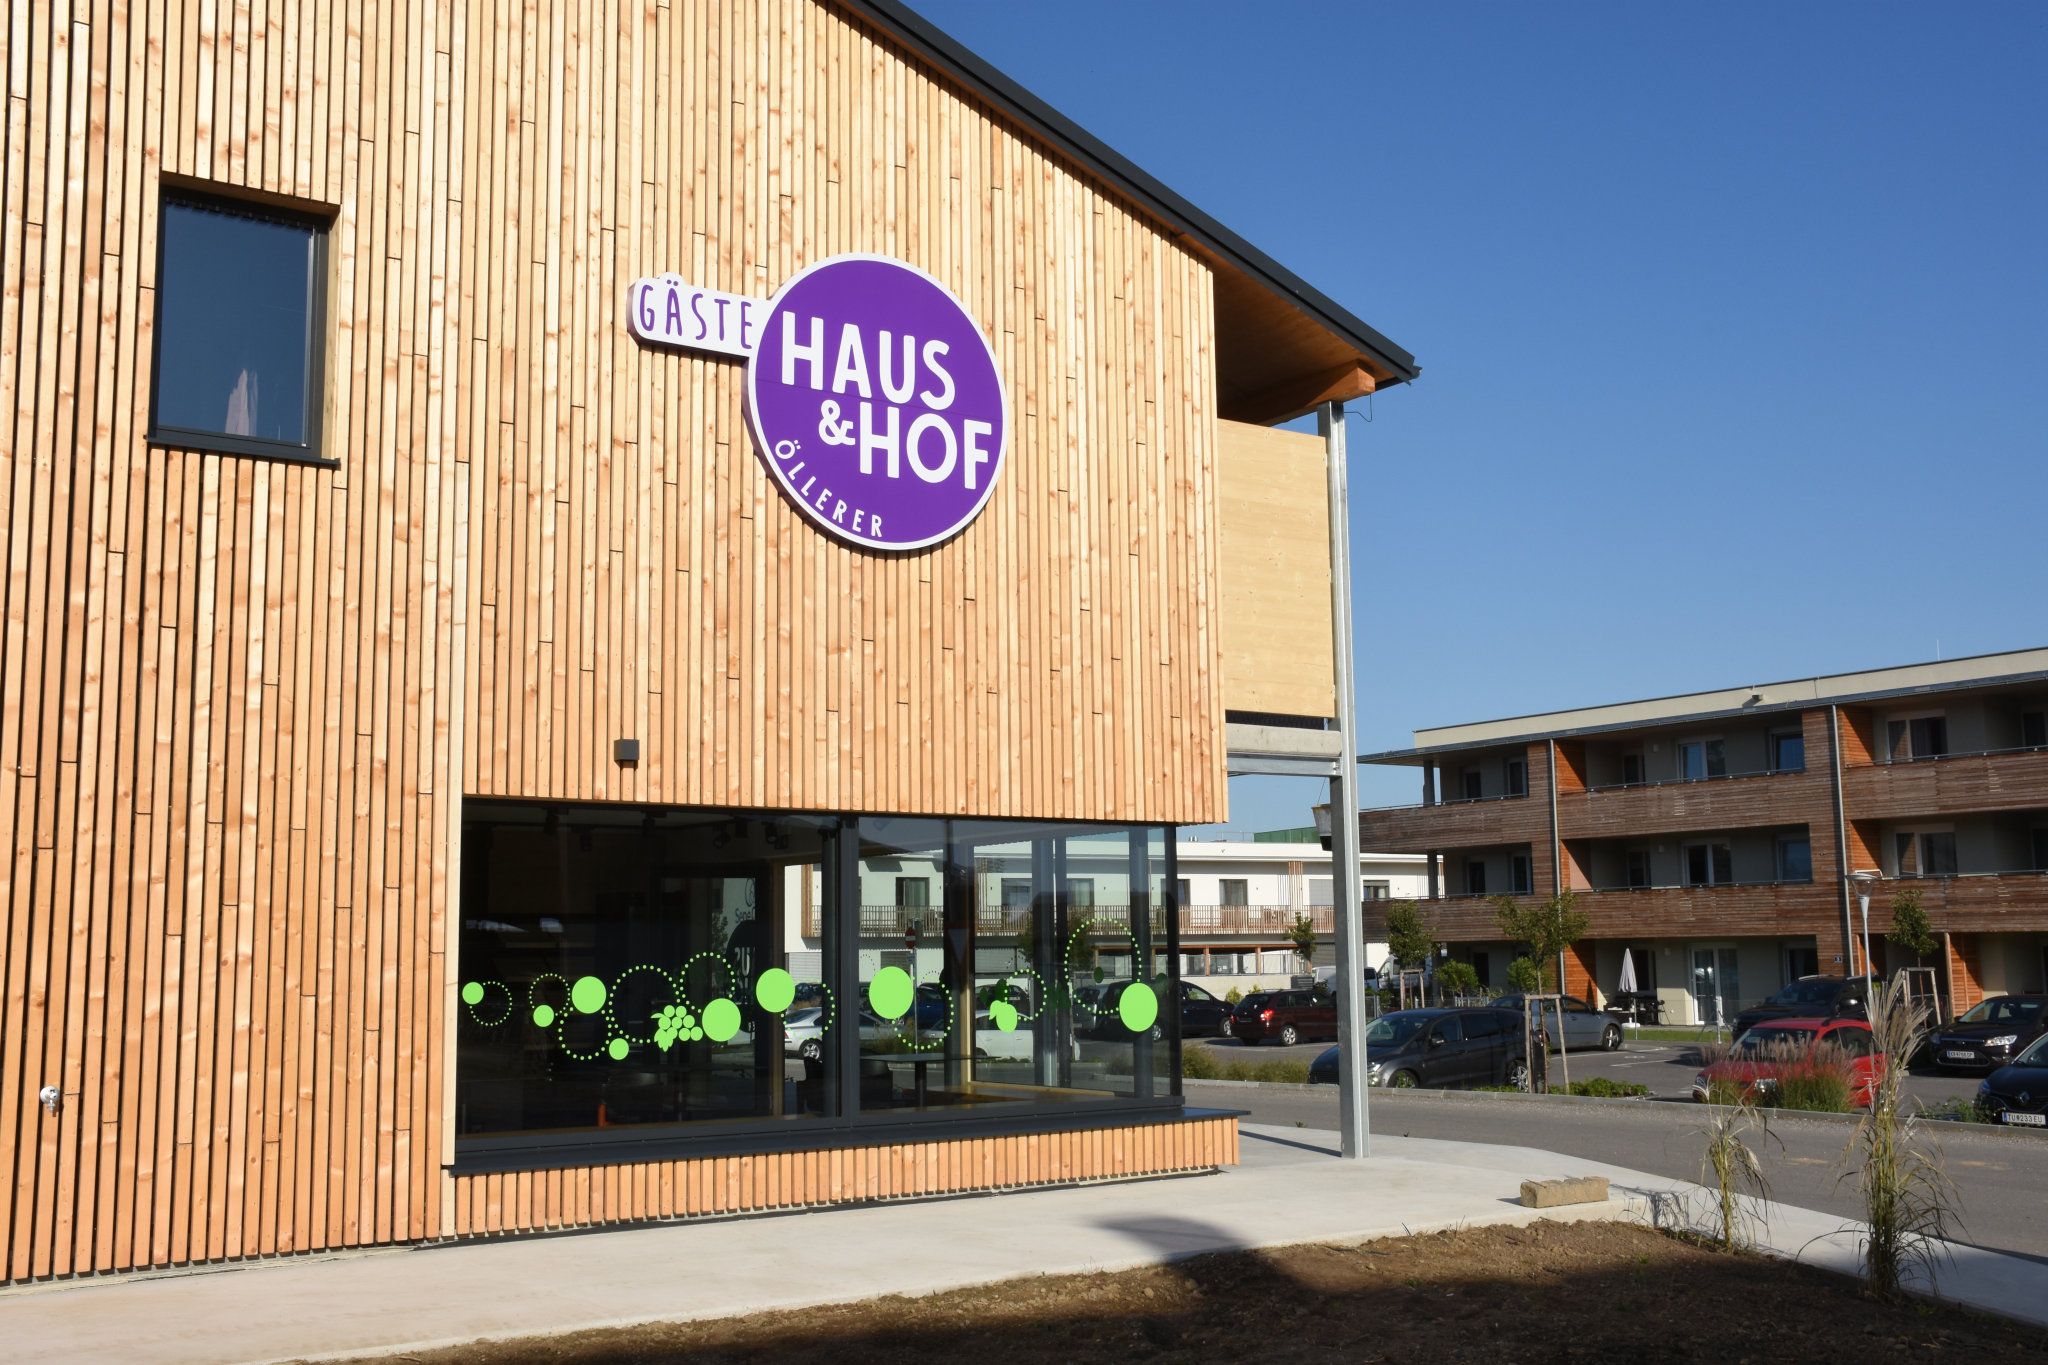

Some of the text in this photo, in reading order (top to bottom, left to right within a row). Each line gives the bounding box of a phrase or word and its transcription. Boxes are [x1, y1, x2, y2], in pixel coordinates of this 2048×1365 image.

[640, 278, 753, 350] GÄSTE
[781, 310, 956, 411] HAUS
[775, 438, 883, 538] ÖLLERER
